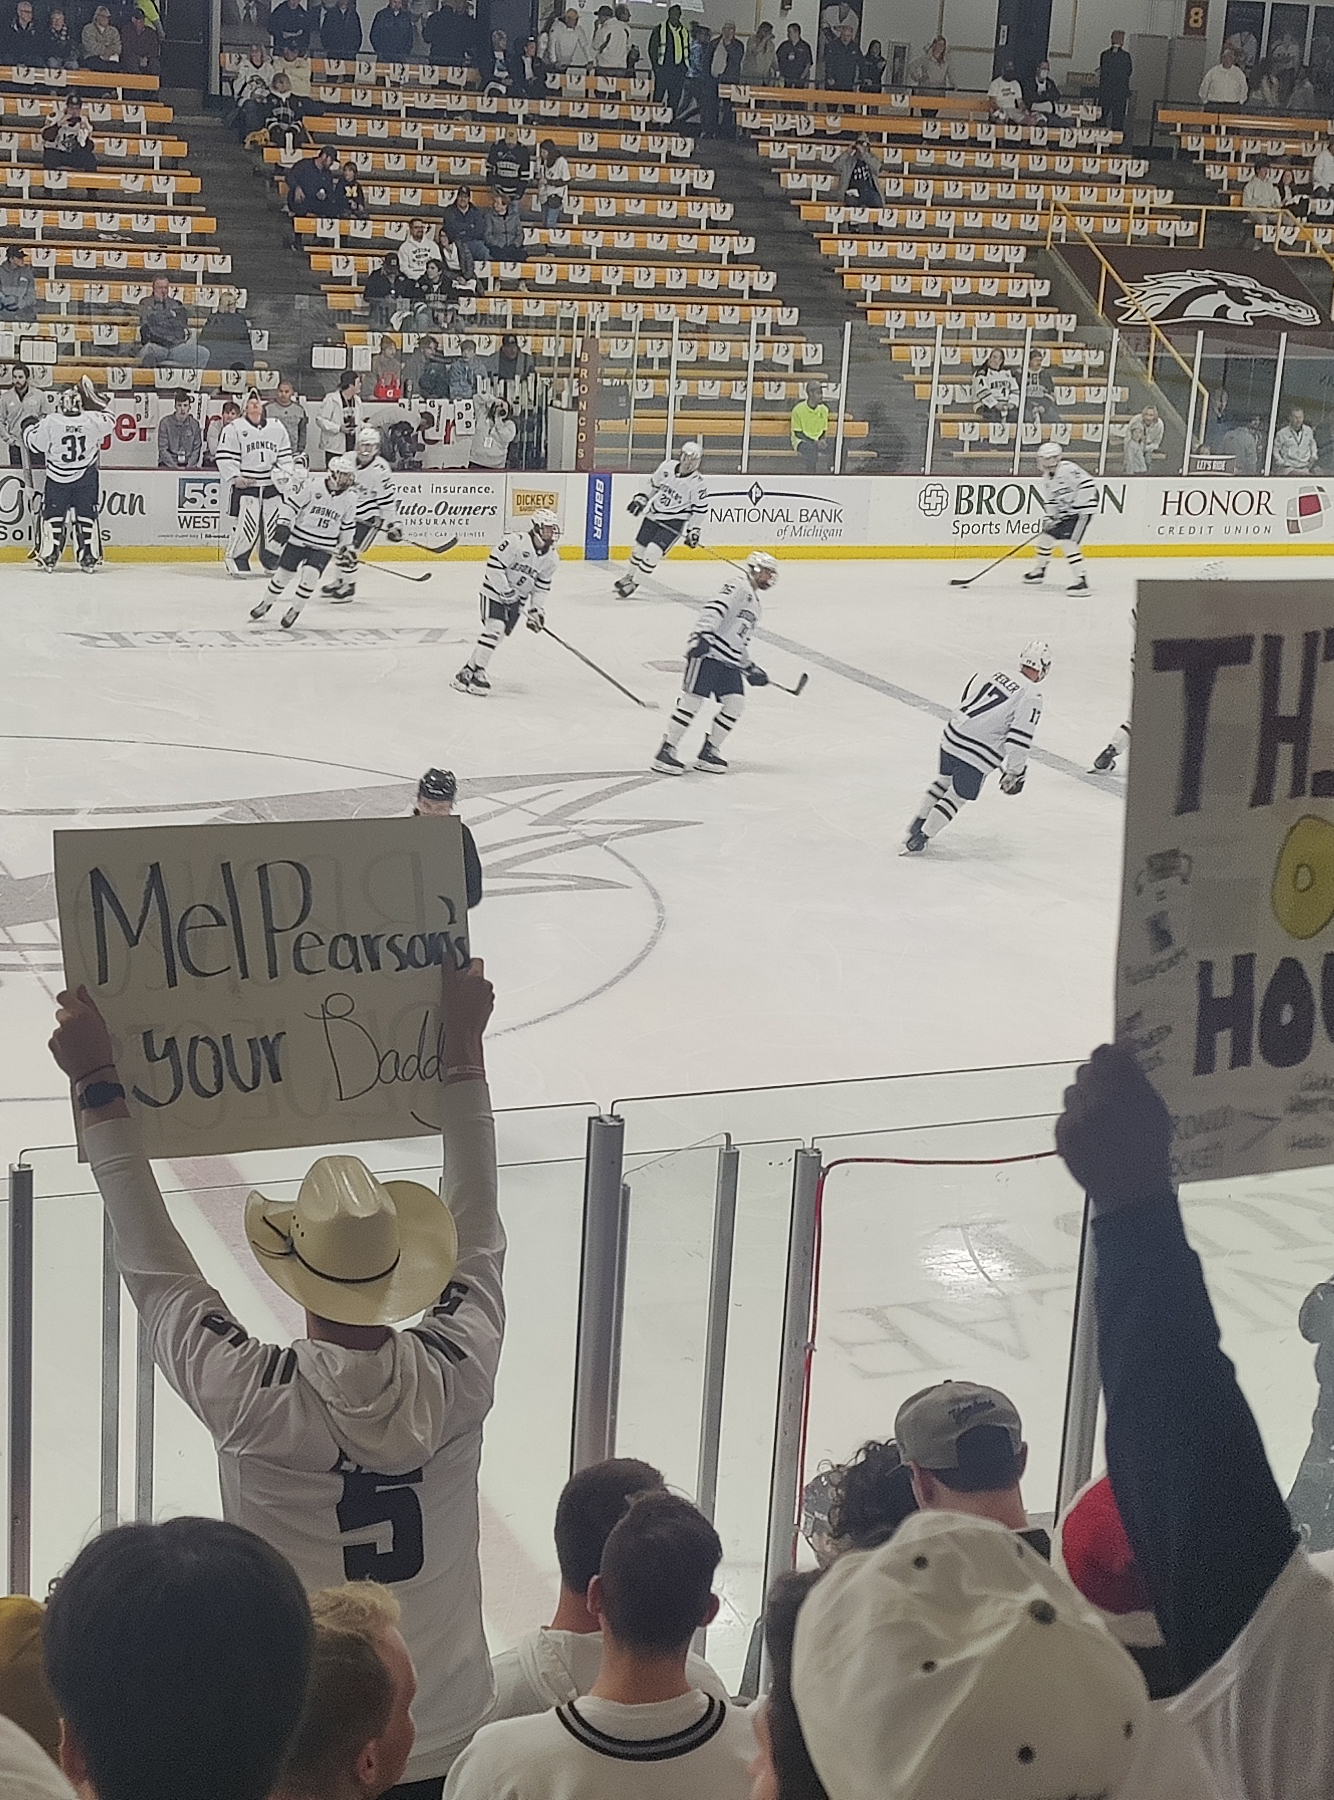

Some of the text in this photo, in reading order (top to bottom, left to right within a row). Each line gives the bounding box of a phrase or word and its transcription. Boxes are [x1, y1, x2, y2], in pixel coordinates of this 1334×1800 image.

[1189, 7, 1204, 29] 8
[576, 351, 589, 459] BRONCOS
[60, 435, 87, 463] 31
[515, 494, 555, 506] DICKEY'S
[954, 483, 1127, 515] BRONN
[1160, 489, 1276, 517] HONOR
[178, 516, 220, 529] WEST
[404, 518, 470, 526] INSURANCE
[709, 507, 844, 524] NATIONAL BANK
[776, 524, 843, 541] of Michigan
[951, 519, 1001, 538] Sports
[1157, 525, 1273, 536] CREDIT UNION
[959, 681, 1010, 719] 17
[131, 992, 446, 1131] your Dadd
[335, 1466, 425, 1585] 5
